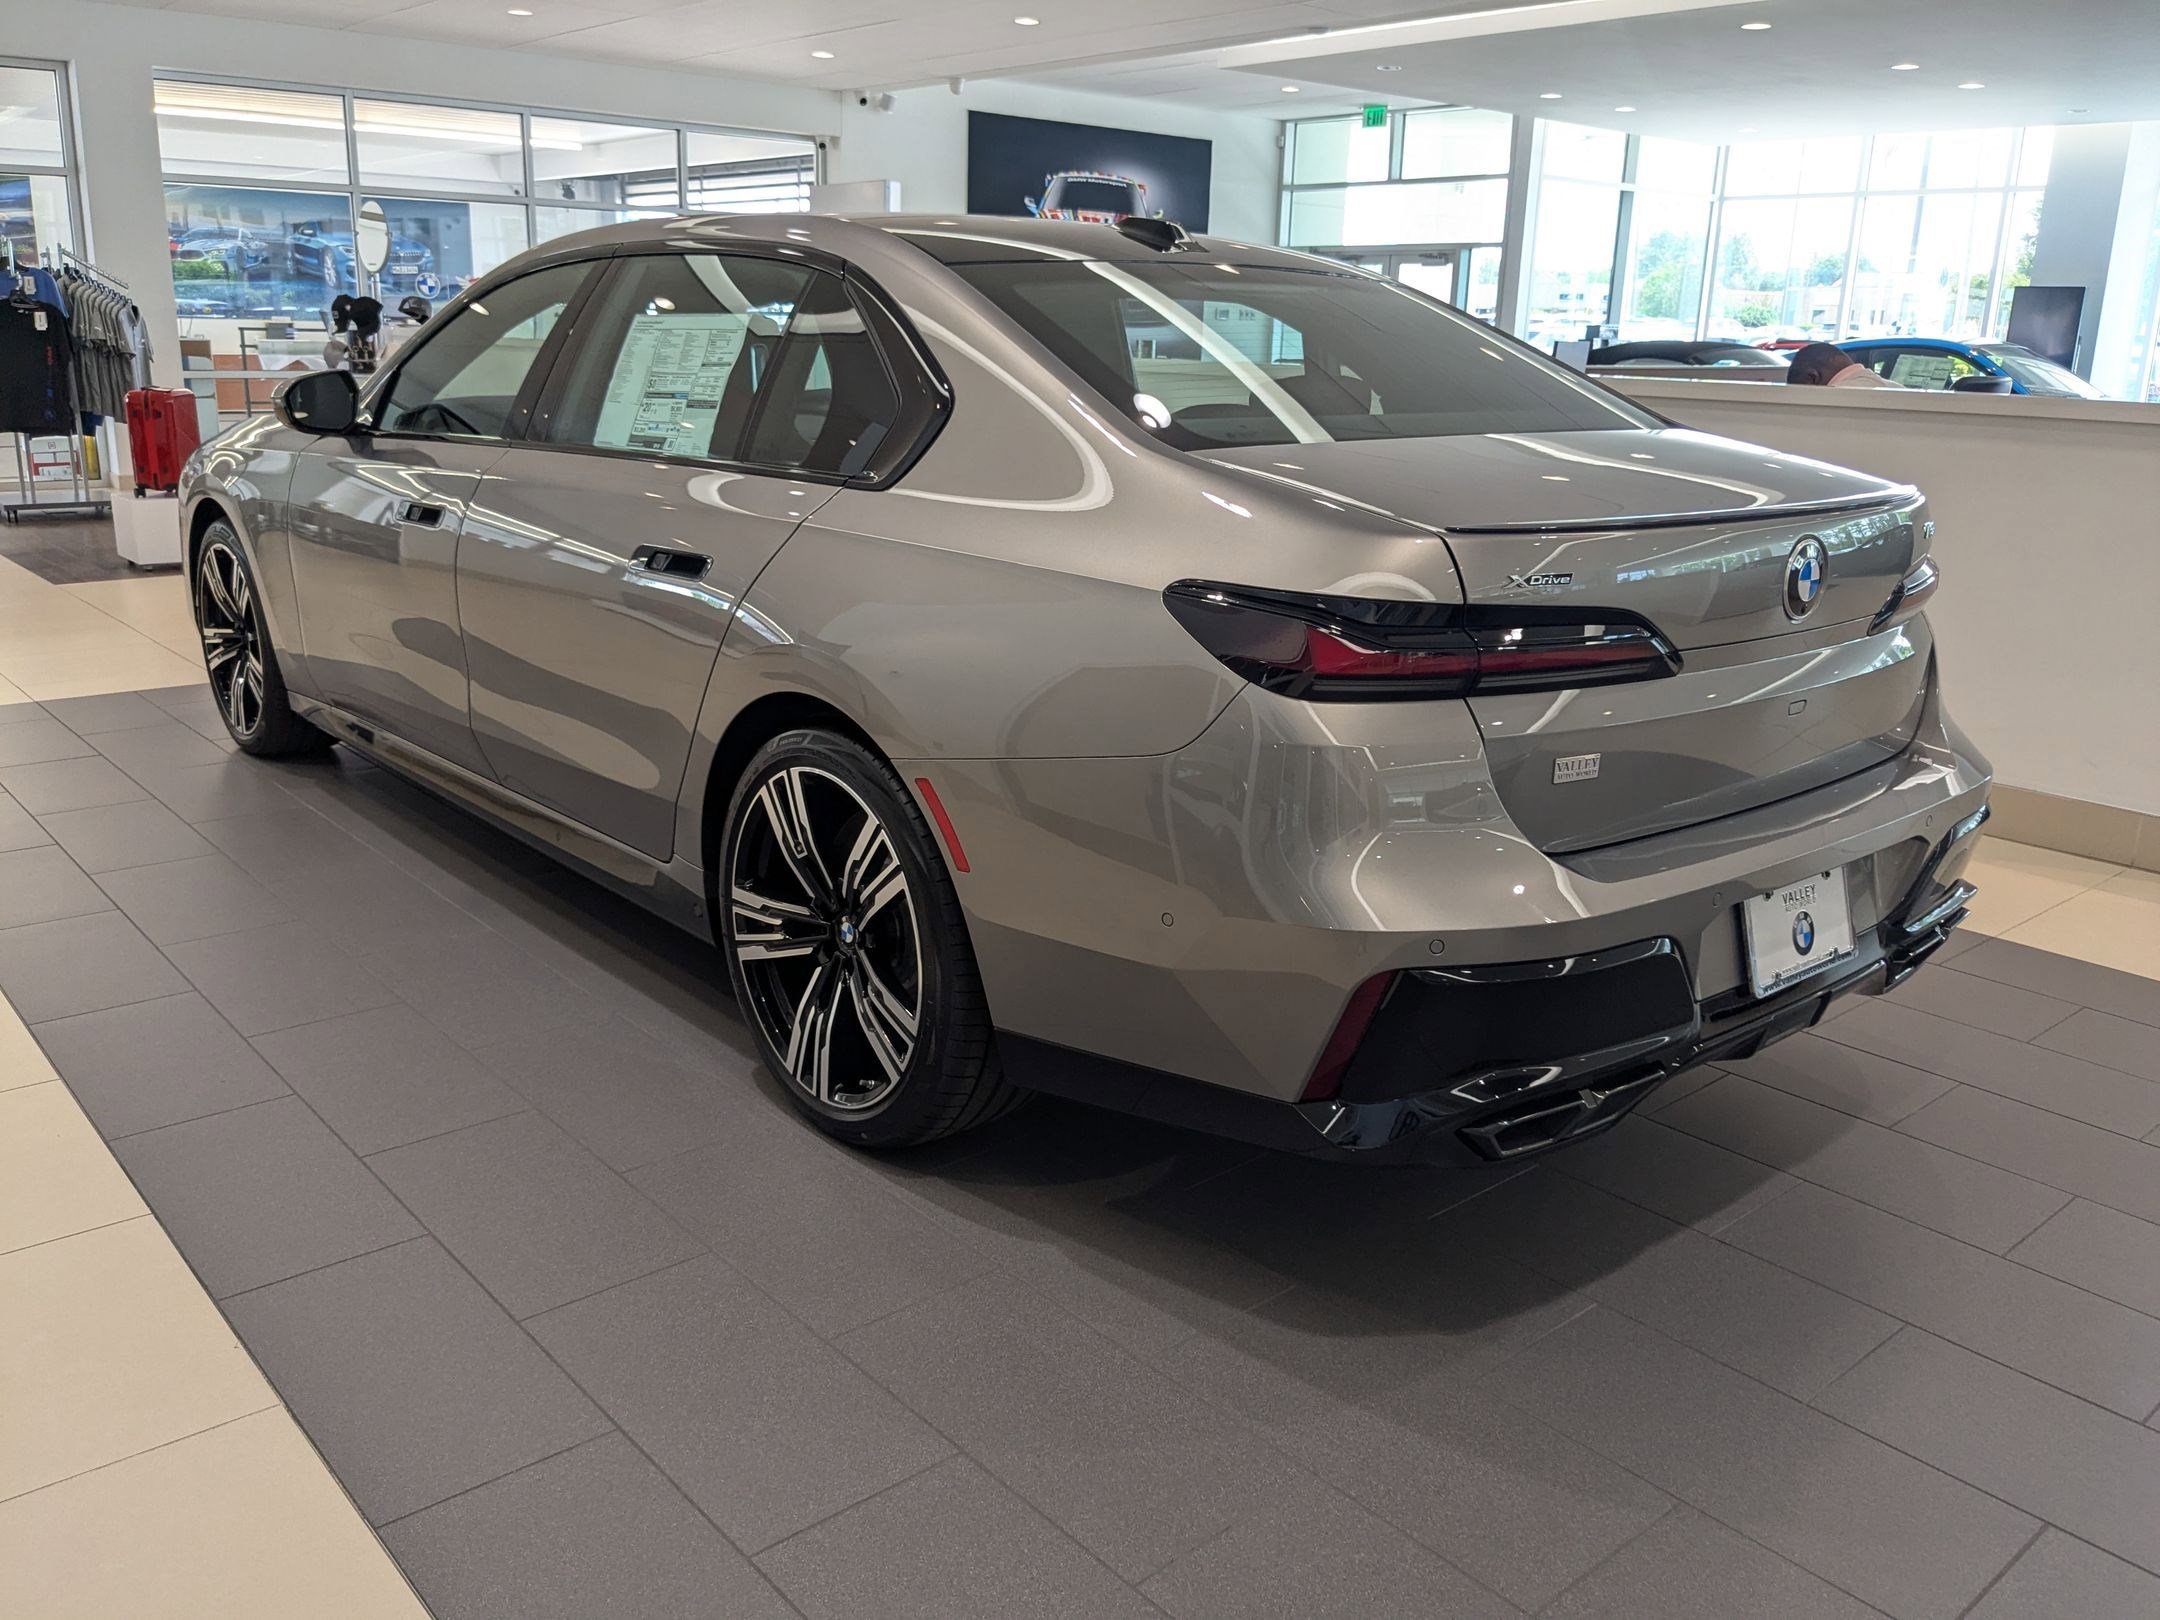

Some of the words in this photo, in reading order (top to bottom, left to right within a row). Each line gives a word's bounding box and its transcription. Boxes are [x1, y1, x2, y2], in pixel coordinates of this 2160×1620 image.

[1366, 110, 1384, 126] EXIT
[1556, 757, 1599, 772] VALLEY
[1782, 884, 1816, 905] VALLEY
